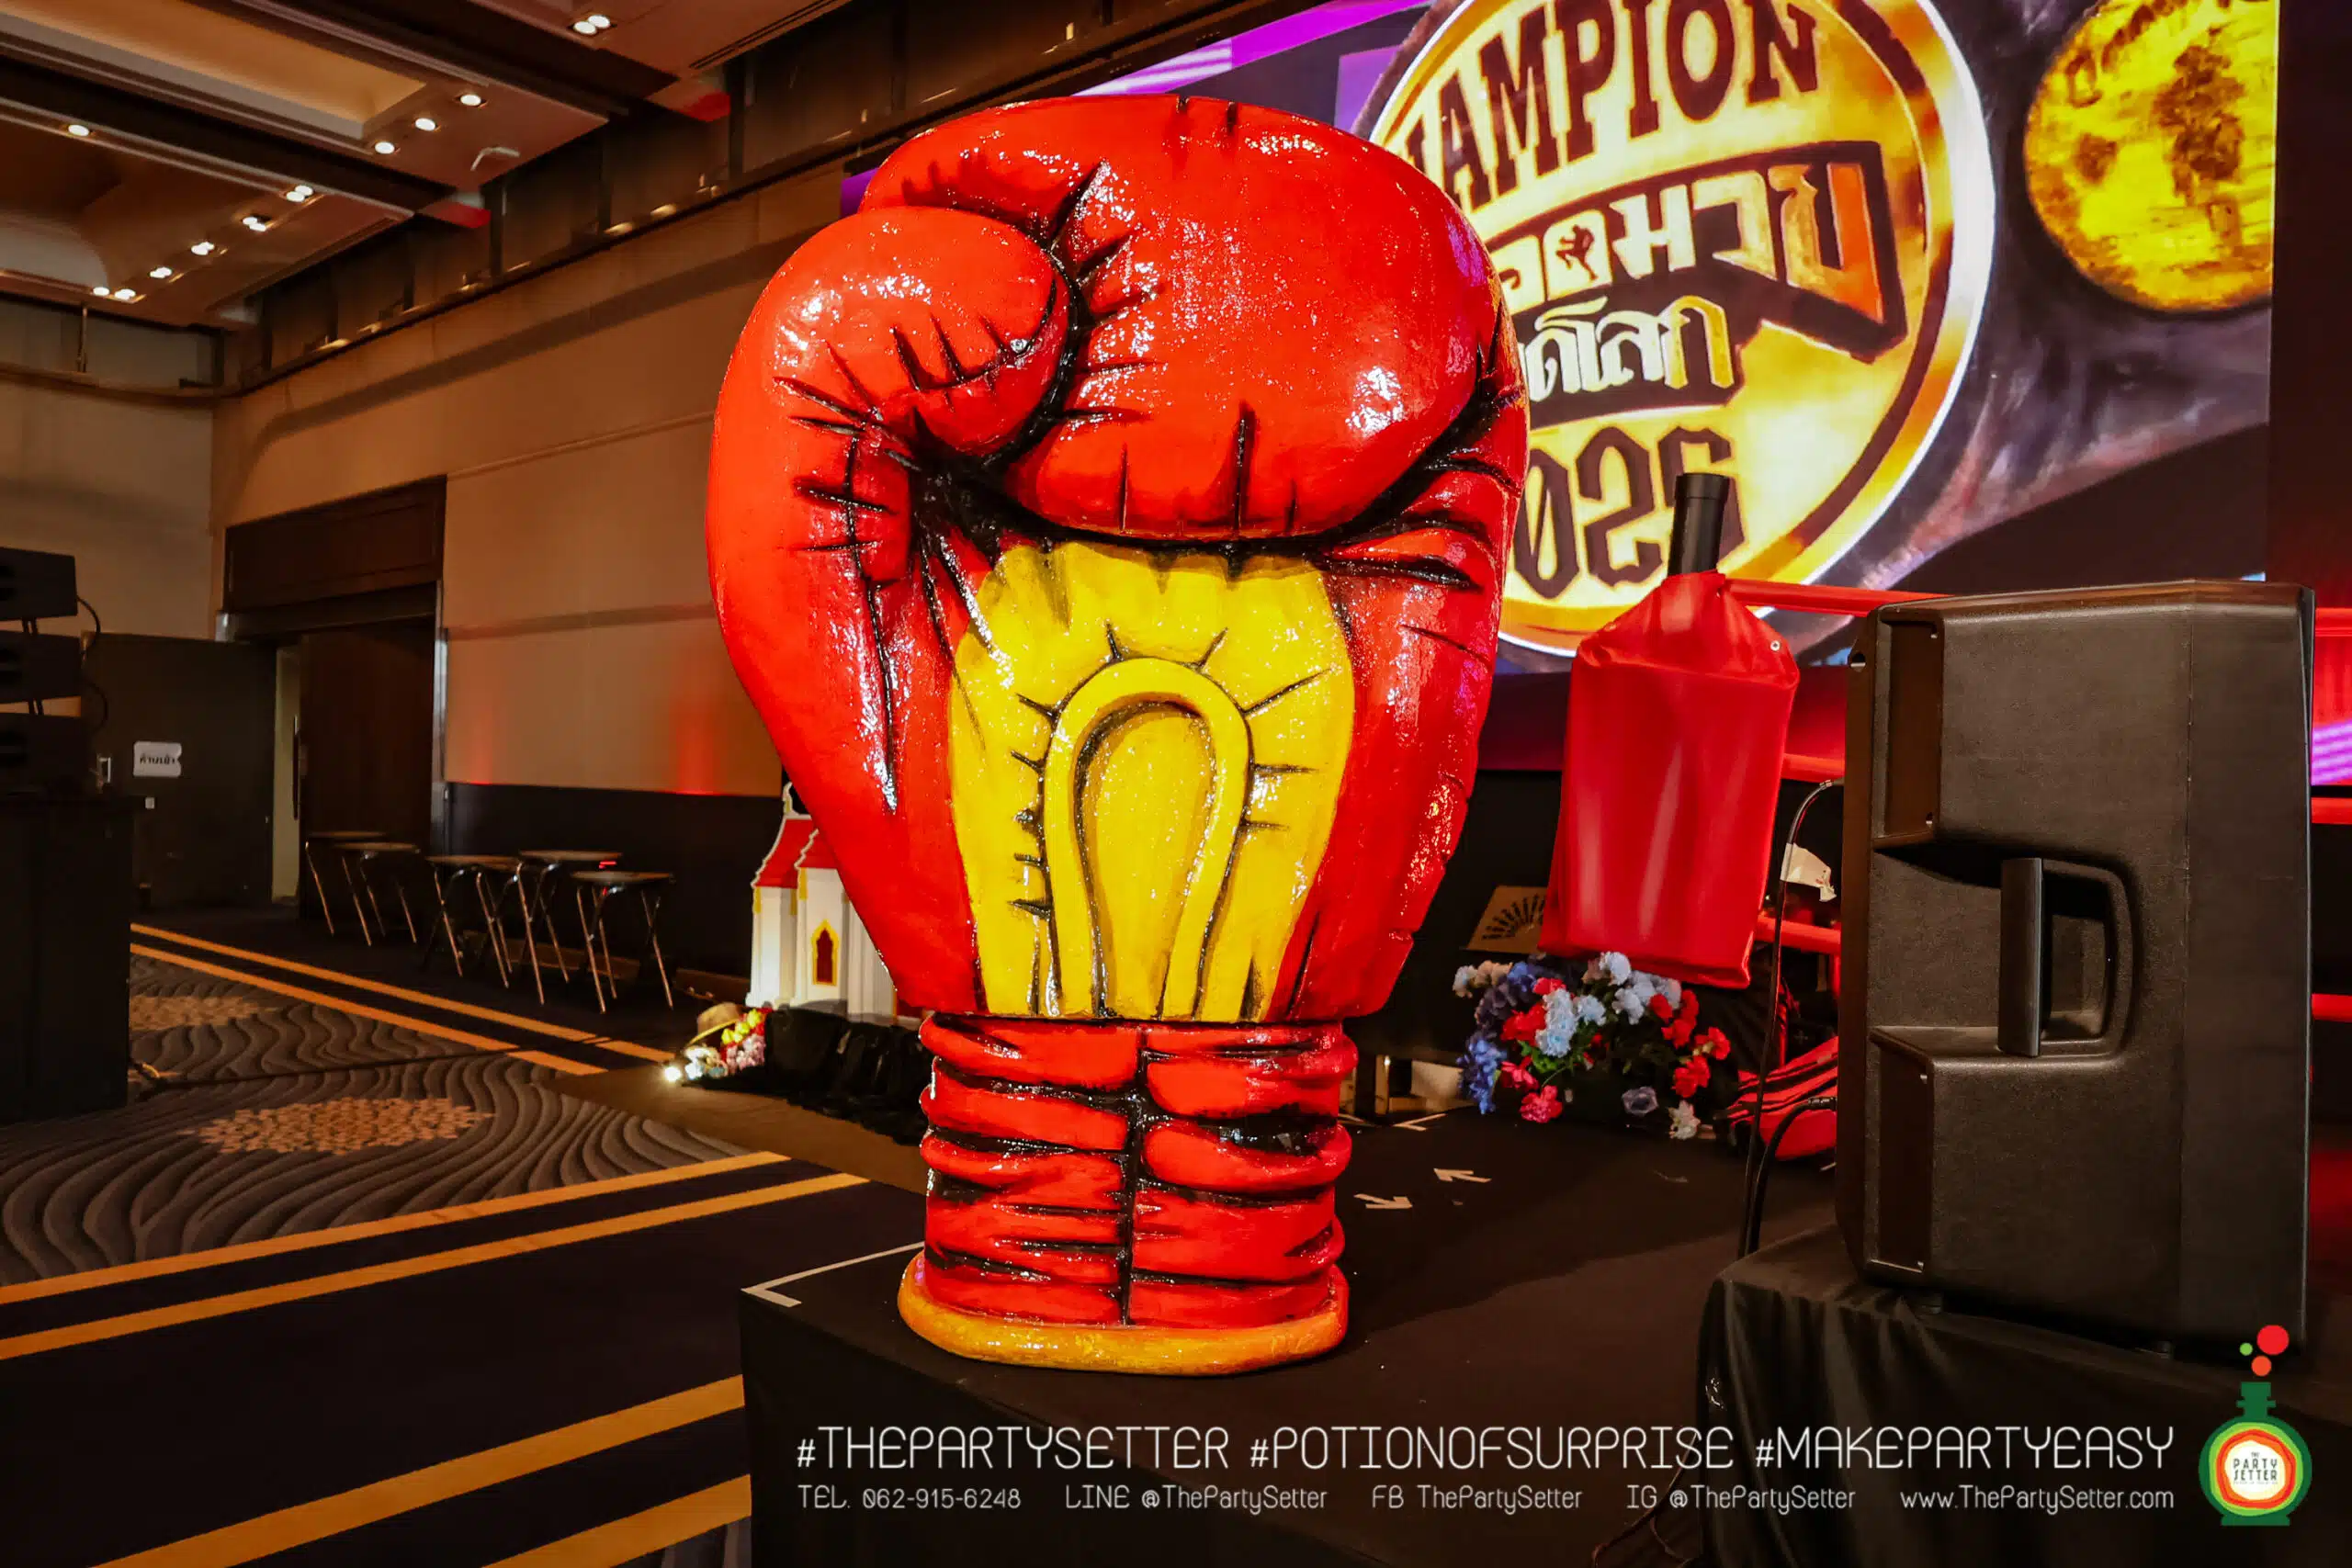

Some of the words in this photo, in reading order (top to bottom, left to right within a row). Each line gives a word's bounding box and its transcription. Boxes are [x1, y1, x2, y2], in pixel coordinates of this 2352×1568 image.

[1490, 162, 1883, 323] อดมวย
[1518, 295, 1735, 402] ดโลก
[1514, 426, 1746, 598] 025
